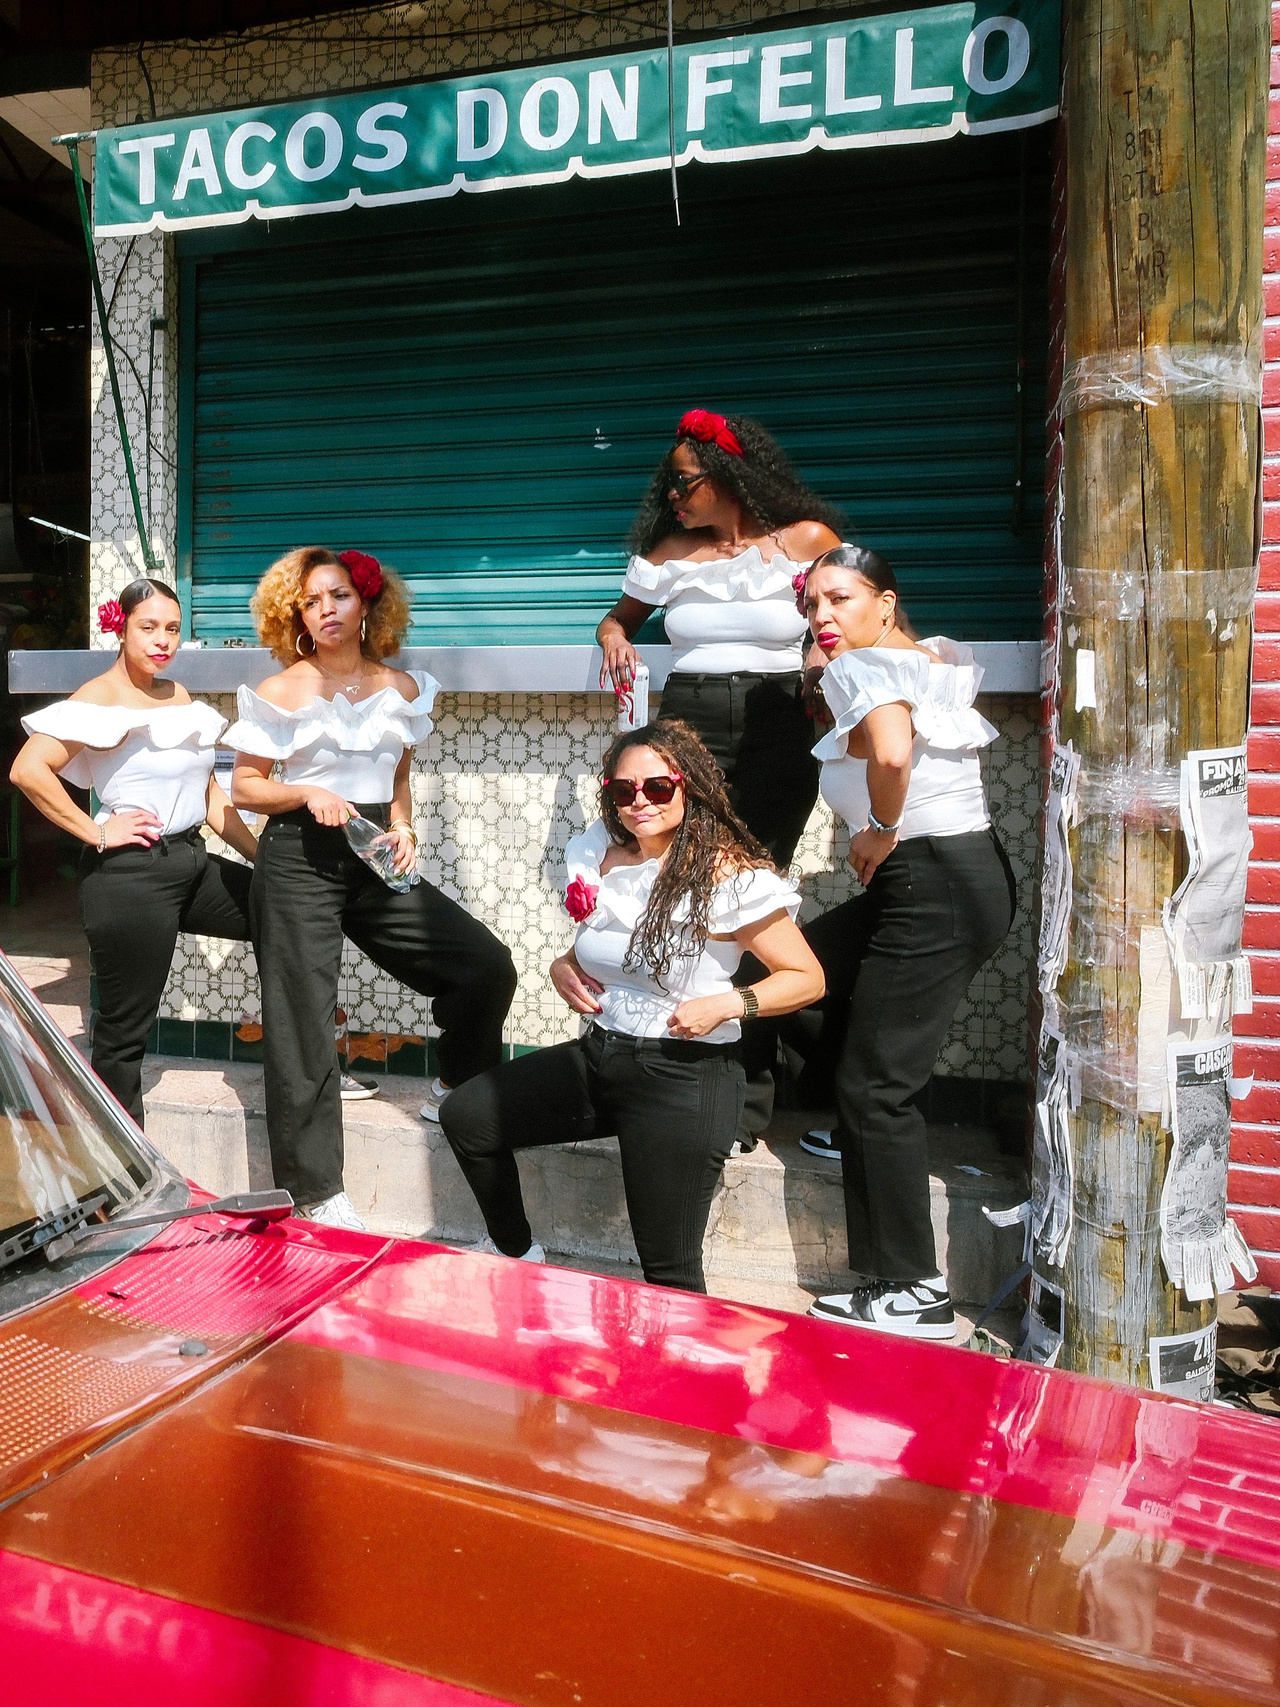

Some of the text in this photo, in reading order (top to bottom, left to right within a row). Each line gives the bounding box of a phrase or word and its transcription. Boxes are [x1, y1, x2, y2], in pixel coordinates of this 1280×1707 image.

[119, 15, 1031, 206] TACOS DON FELLO
